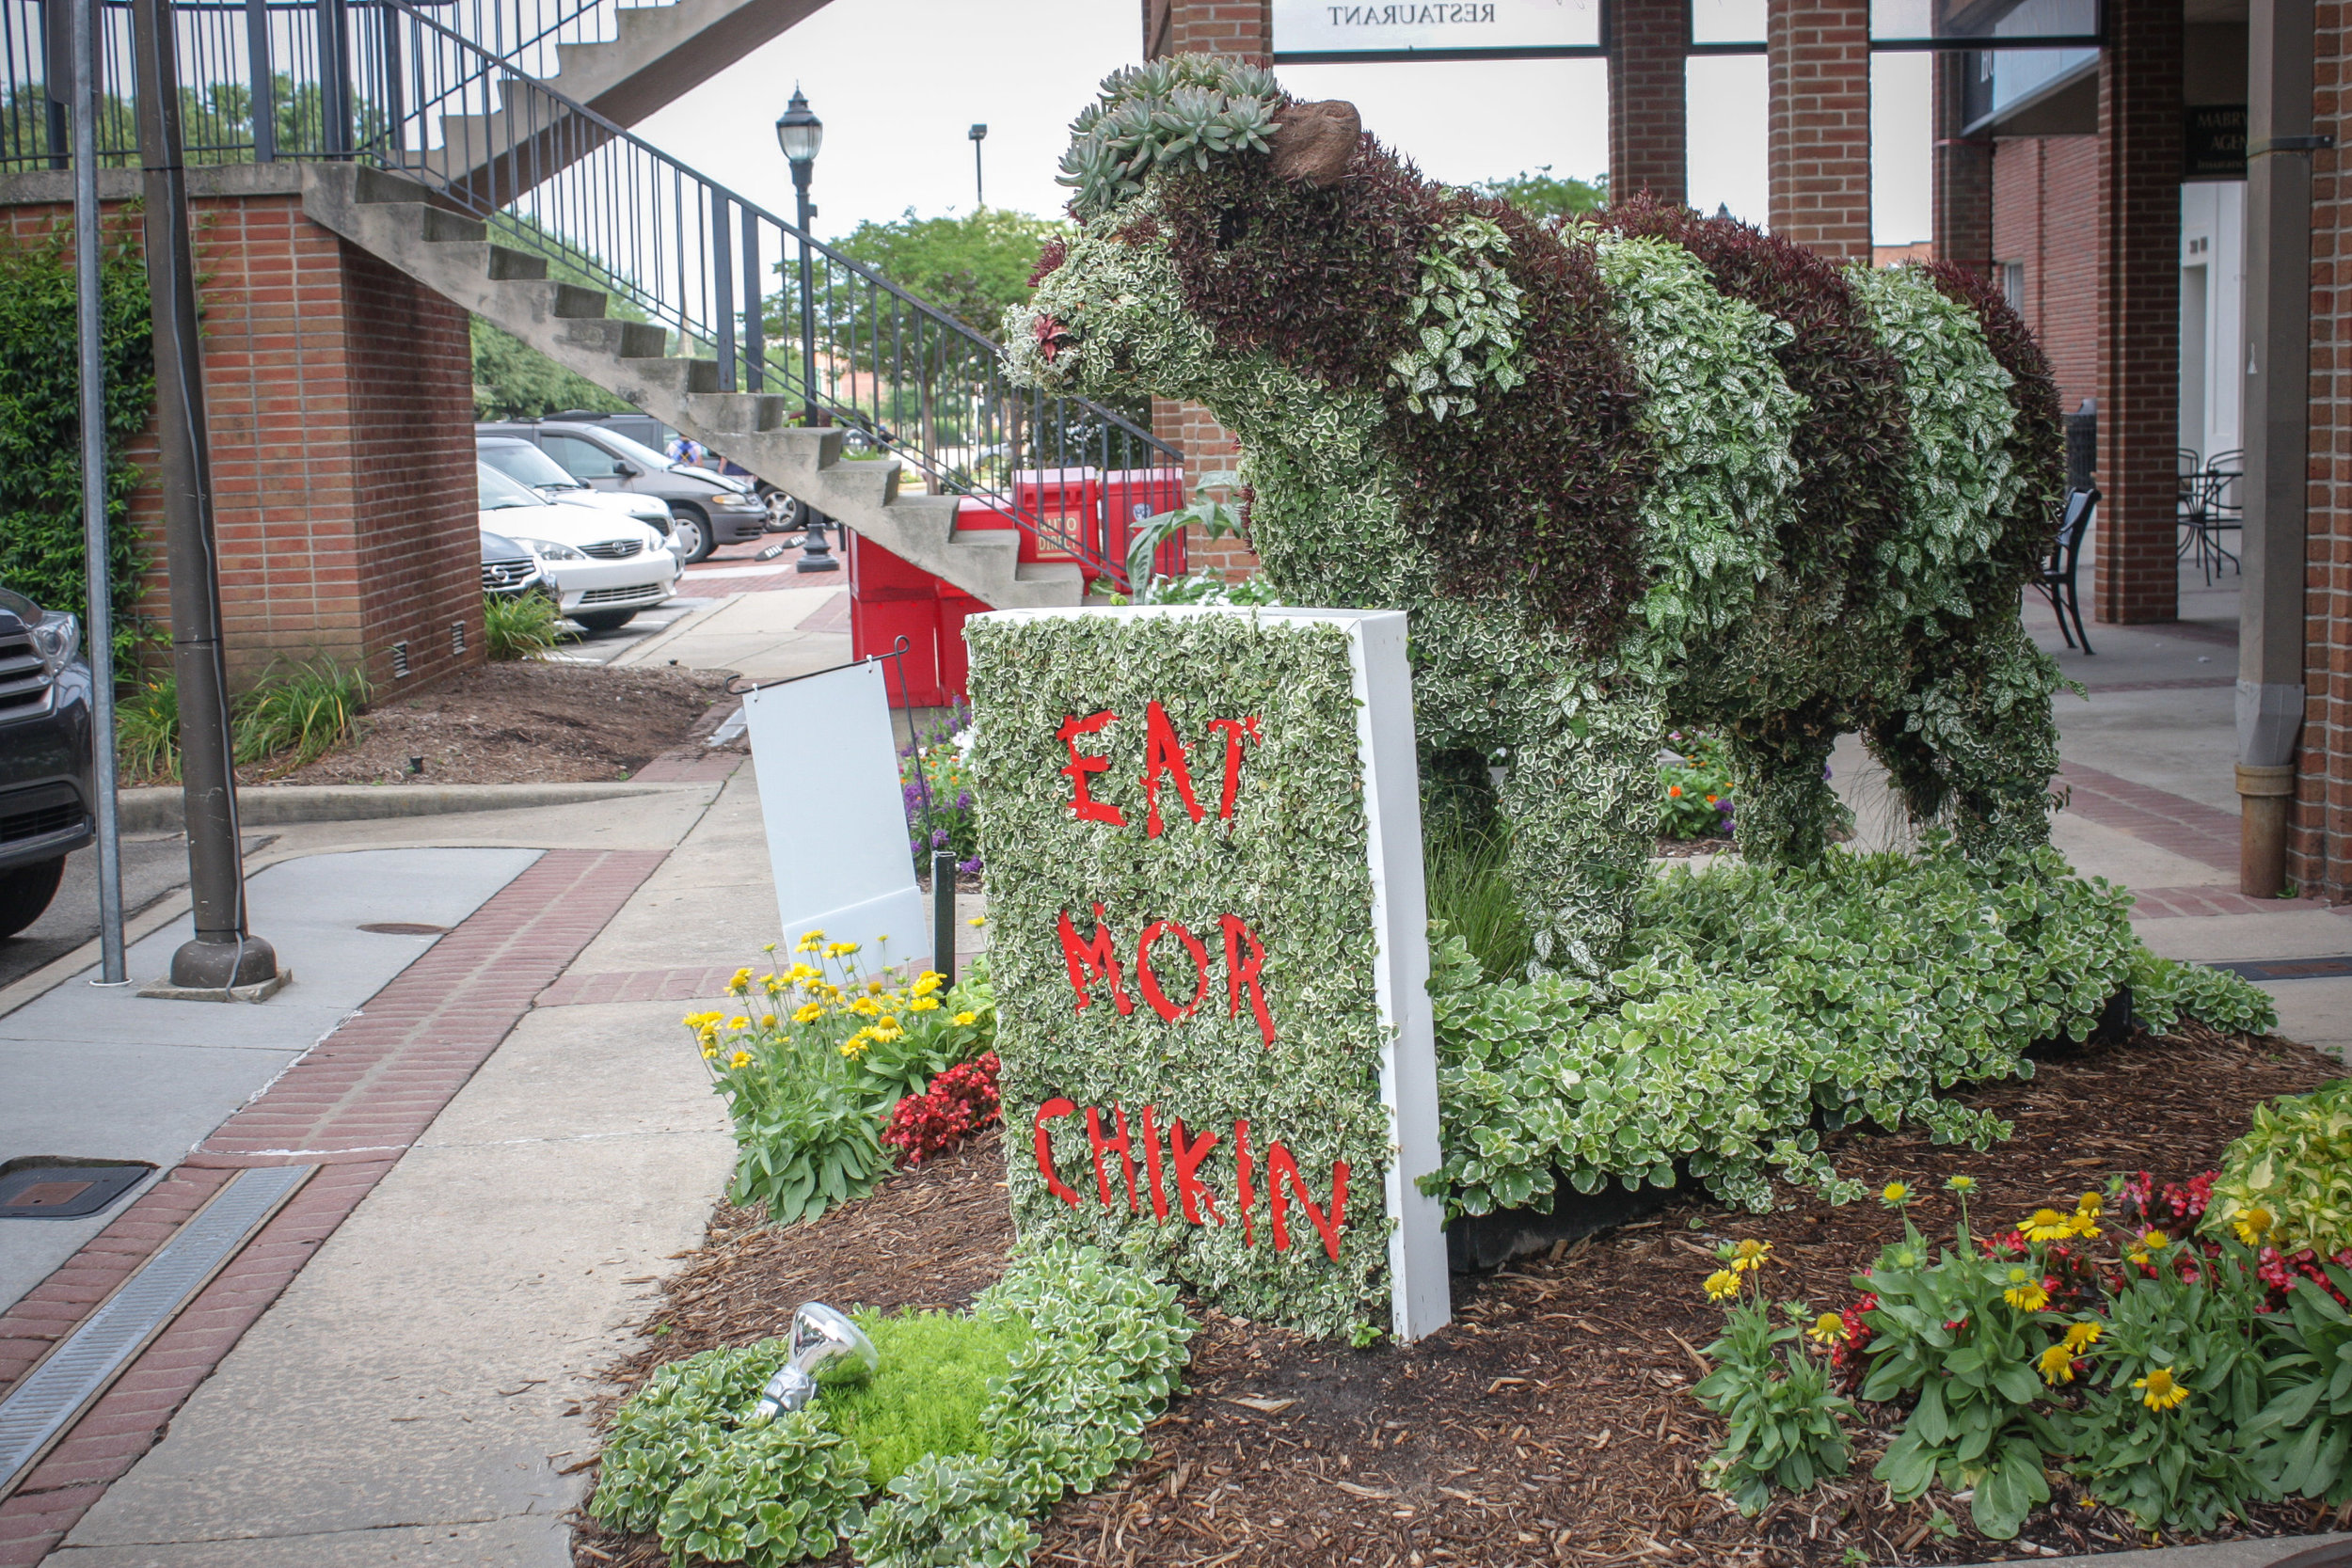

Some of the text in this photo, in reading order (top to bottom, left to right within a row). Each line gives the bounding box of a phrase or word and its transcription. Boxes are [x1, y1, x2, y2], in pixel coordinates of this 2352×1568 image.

[1056, 699, 1262, 840] EAT
[1058, 902, 1276, 1049] MOR
[1035, 1098, 1349, 1262] CHIKIN
